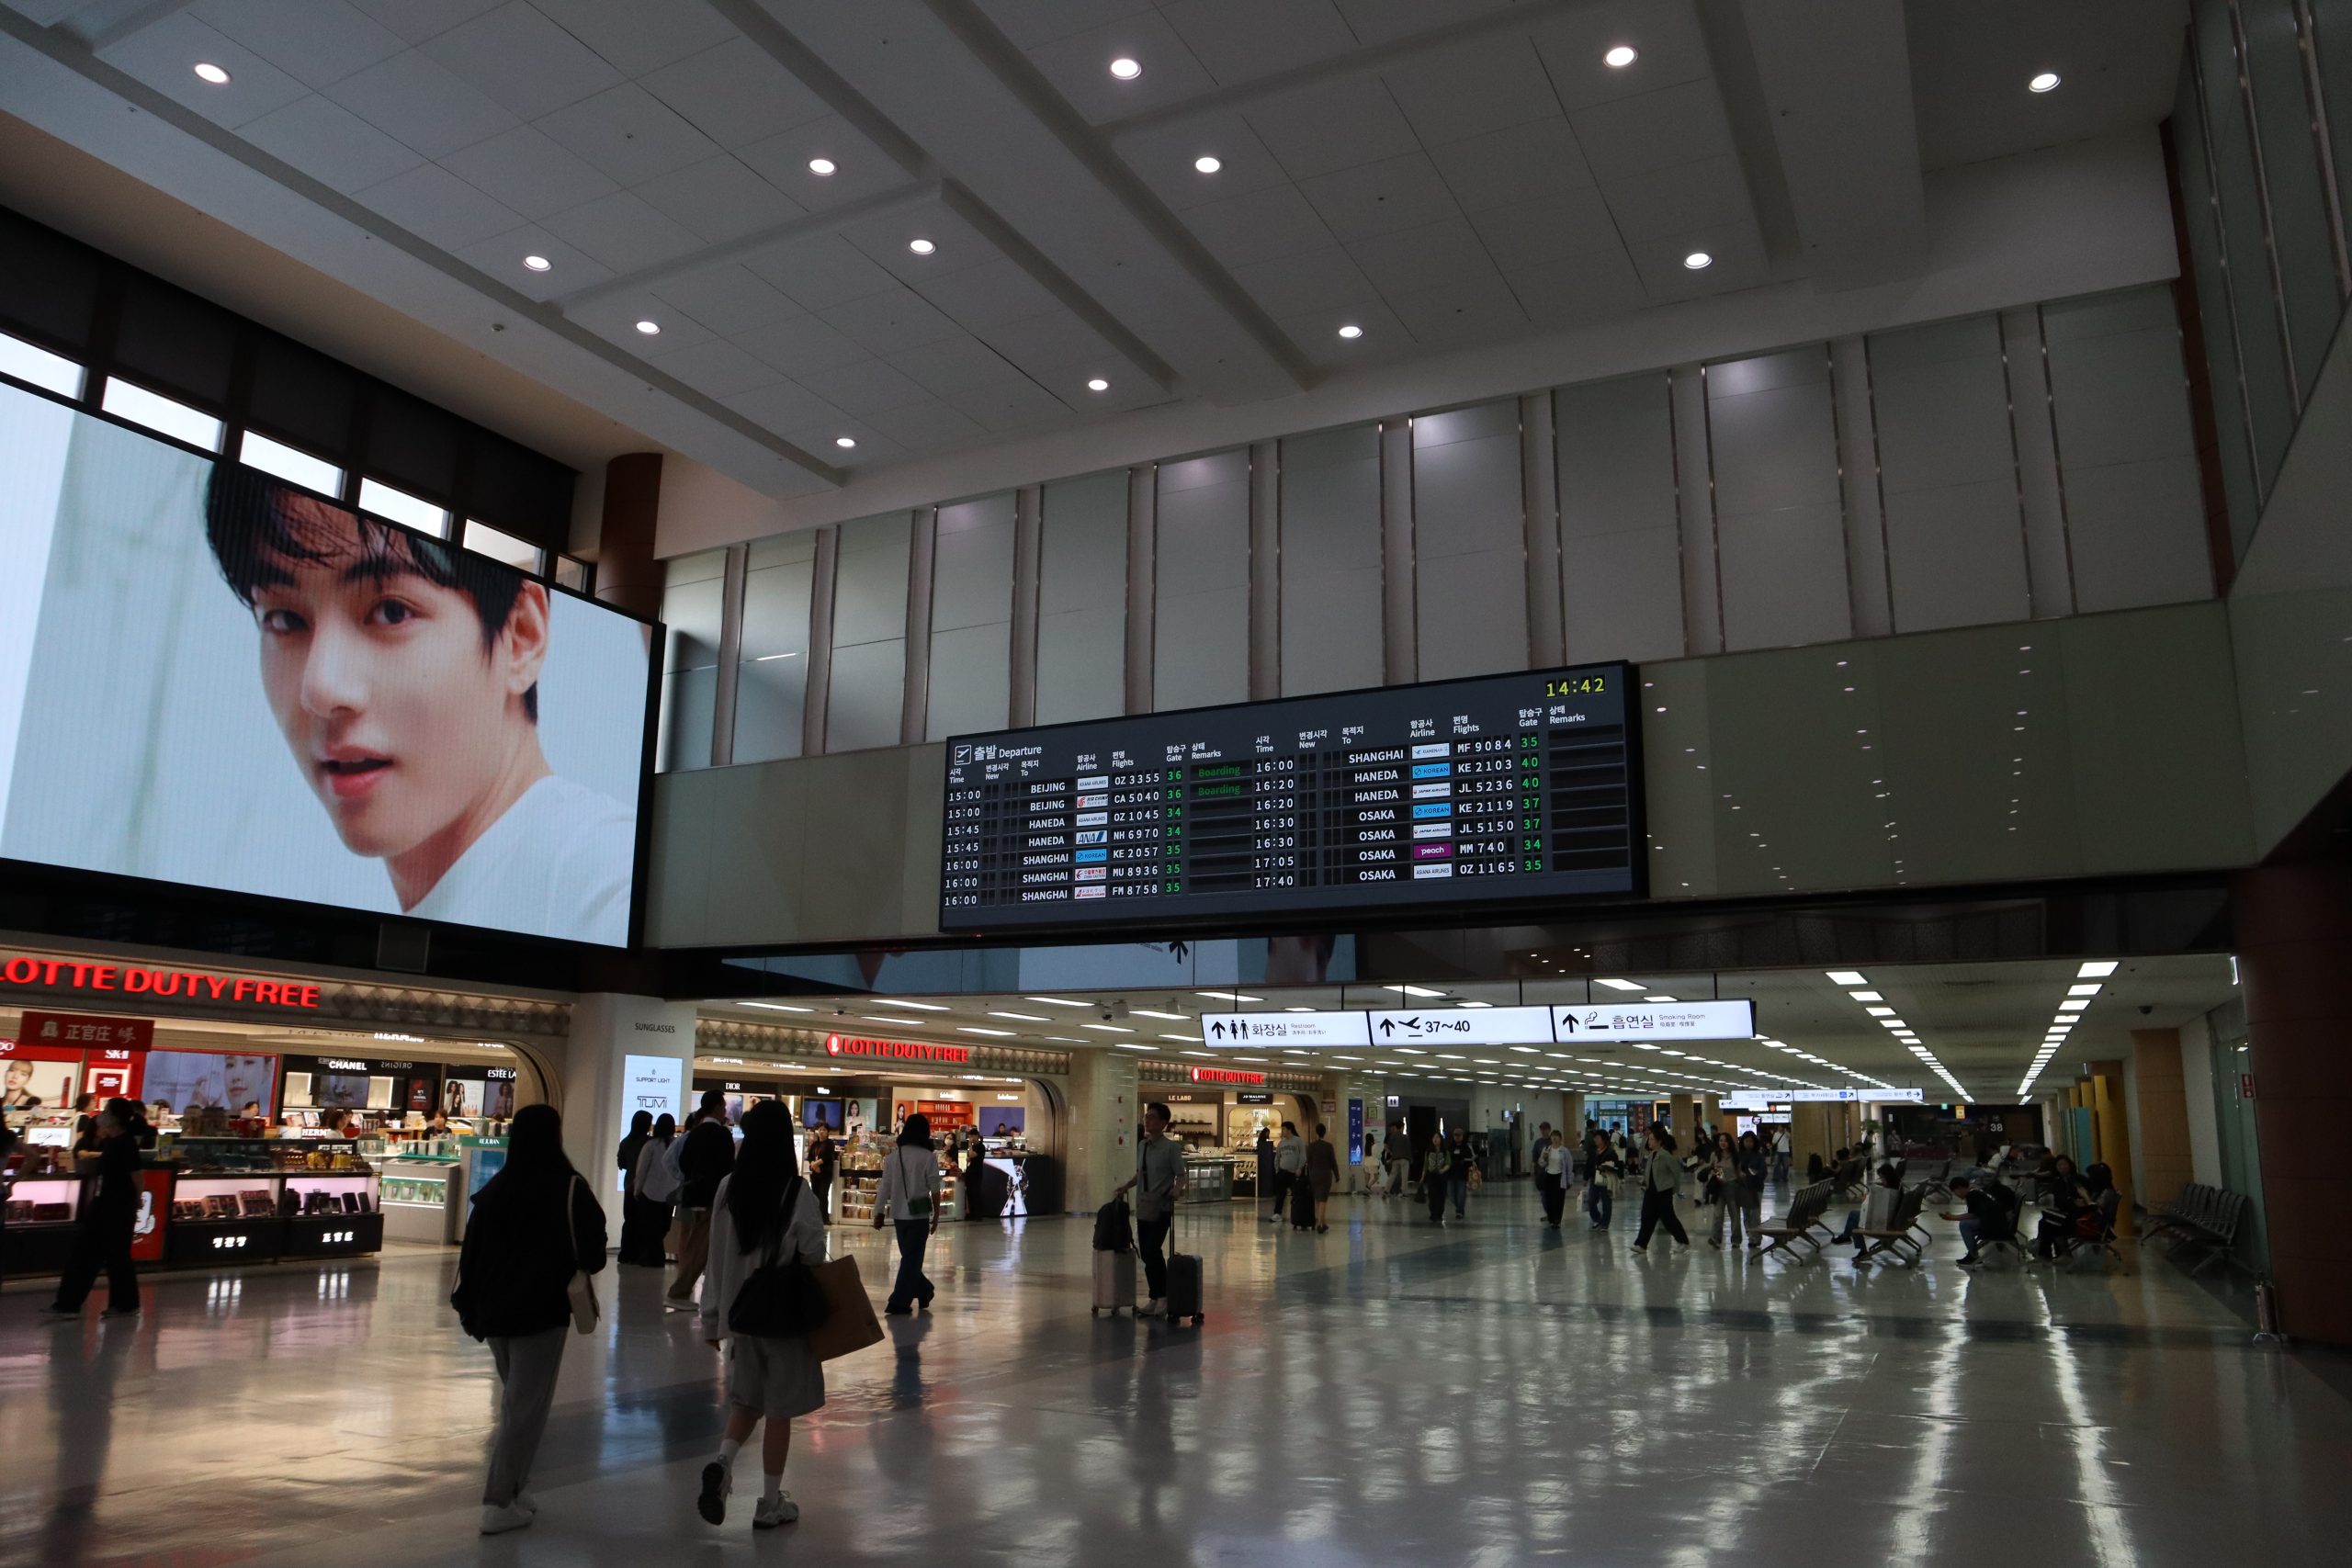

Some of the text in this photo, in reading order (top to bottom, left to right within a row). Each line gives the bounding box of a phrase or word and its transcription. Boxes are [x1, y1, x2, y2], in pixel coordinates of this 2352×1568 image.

[1546, 678, 1604, 697] 14:42
[1410, 714, 1585, 738] Airline Flights Gate Remarks
[974, 745, 1042, 761] 출발 Departure
[1256, 745, 1273, 753] Time
[1299, 740, 1316, 749] New
[1257, 761, 1293, 773] 16:00
[1349, 750, 1404, 763] SHANGHAI
[1458, 743, 1470, 752] MF
[1476, 739, 1511, 752] 9084
[1521, 738, 1537, 748] 35
[1077, 762, 1097, 771] Airline
[1113, 760, 1134, 768] Flights
[1192, 750, 1221, 760] Remarks
[949, 791, 980, 801] 15:00
[1031, 783, 1065, 794] BEIJING
[1129, 773, 1159, 784] 3355
[1168, 771, 1182, 780] 36
[1199, 765, 1240, 777] Boarding
[1256, 780, 1294, 792] 16:20
[1355, 770, 1398, 783] HANEDA
[1458, 763, 1471, 773] KE
[1476, 760, 1511, 772] 2103
[1521, 758, 1538, 768] 40
[948, 808, 979, 818] 15:00
[1031, 800, 1064, 811] BEIJING
[1114, 795, 1125, 803] CA
[1129, 792, 1159, 802] 5040
[1168, 790, 1181, 798] 36
[1199, 785, 1240, 795] Boarding
[1257, 798, 1293, 810] 16:20
[1355, 789, 1398, 802] HANEDA
[1459, 784, 1472, 793] JL
[1476, 780, 1512, 792] 5236
[1522, 778, 1539, 788] 40
[948, 826, 978, 836] 15:45
[1029, 818, 1065, 829] HANEDA
[1114, 813, 1125, 821] OZ
[1129, 810, 1159, 820] 1045
[1168, 808, 1181, 818] 34
[1256, 818, 1294, 829] 16:30
[1359, 810, 1395, 821] OSAKA
[1459, 804, 1472, 813] KE
[1476, 800, 1513, 813] 2119
[1523, 798, 1539, 808] 37
[947, 828, 1181, 853] 15:45 HANEDA ANA NH 6970 34
[1257, 837, 1293, 849] 16:30
[1359, 829, 1395, 840] OSAKA
[1460, 825, 1472, 833] JL
[1477, 821, 1513, 832] 5150
[1523, 818, 1540, 829] 37
[946, 860, 978, 871] 16:00
[1023, 853, 1069, 865] SHANGHAI
[1114, 850, 1125, 858] KE
[1128, 847, 1158, 857] 2057
[1167, 845, 1181, 854] 35
[1256, 840, 1541, 868] 17:05 OSAKA peach MM 740 34
[945, 878, 977, 888] 16:00
[1023, 872, 1068, 883] SHANGHAI
[1114, 868, 1124, 876] MU
[1127, 865, 1158, 875] 8936
[1167, 863, 1181, 874] 35
[1256, 876, 1293, 887] 17:40
[1360, 870, 1396, 881] OSAKA
[1460, 865, 1474, 874] OZ
[1478, 863, 1514, 874] 1165
[1525, 860, 1541, 870] 35
[944, 896, 977, 906] 16:00
[1022, 890, 1067, 900] SHANGHAI
[1113, 886, 1124, 895] FM
[1127, 884, 1158, 895] 8758
[1166, 883, 1180, 892] 35
[0, 958, 321, 1008] OTTE DUTY FREE
[635, 1022, 675, 1033] SUNGLASSES
[1252, 1023, 1286, 1036] 화장실
[1612, 1015, 1654, 1029] 흡연실
[843, 1038, 968, 1062] LOTTE DUTY FREE
[329, 1061, 367, 1070] CHANEL
[1201, 1069, 1264, 1084] LOTTE DUTY FREE
[637, 1096, 667, 1108] TUMI
[1990, 1123, 2003, 1132] 38
